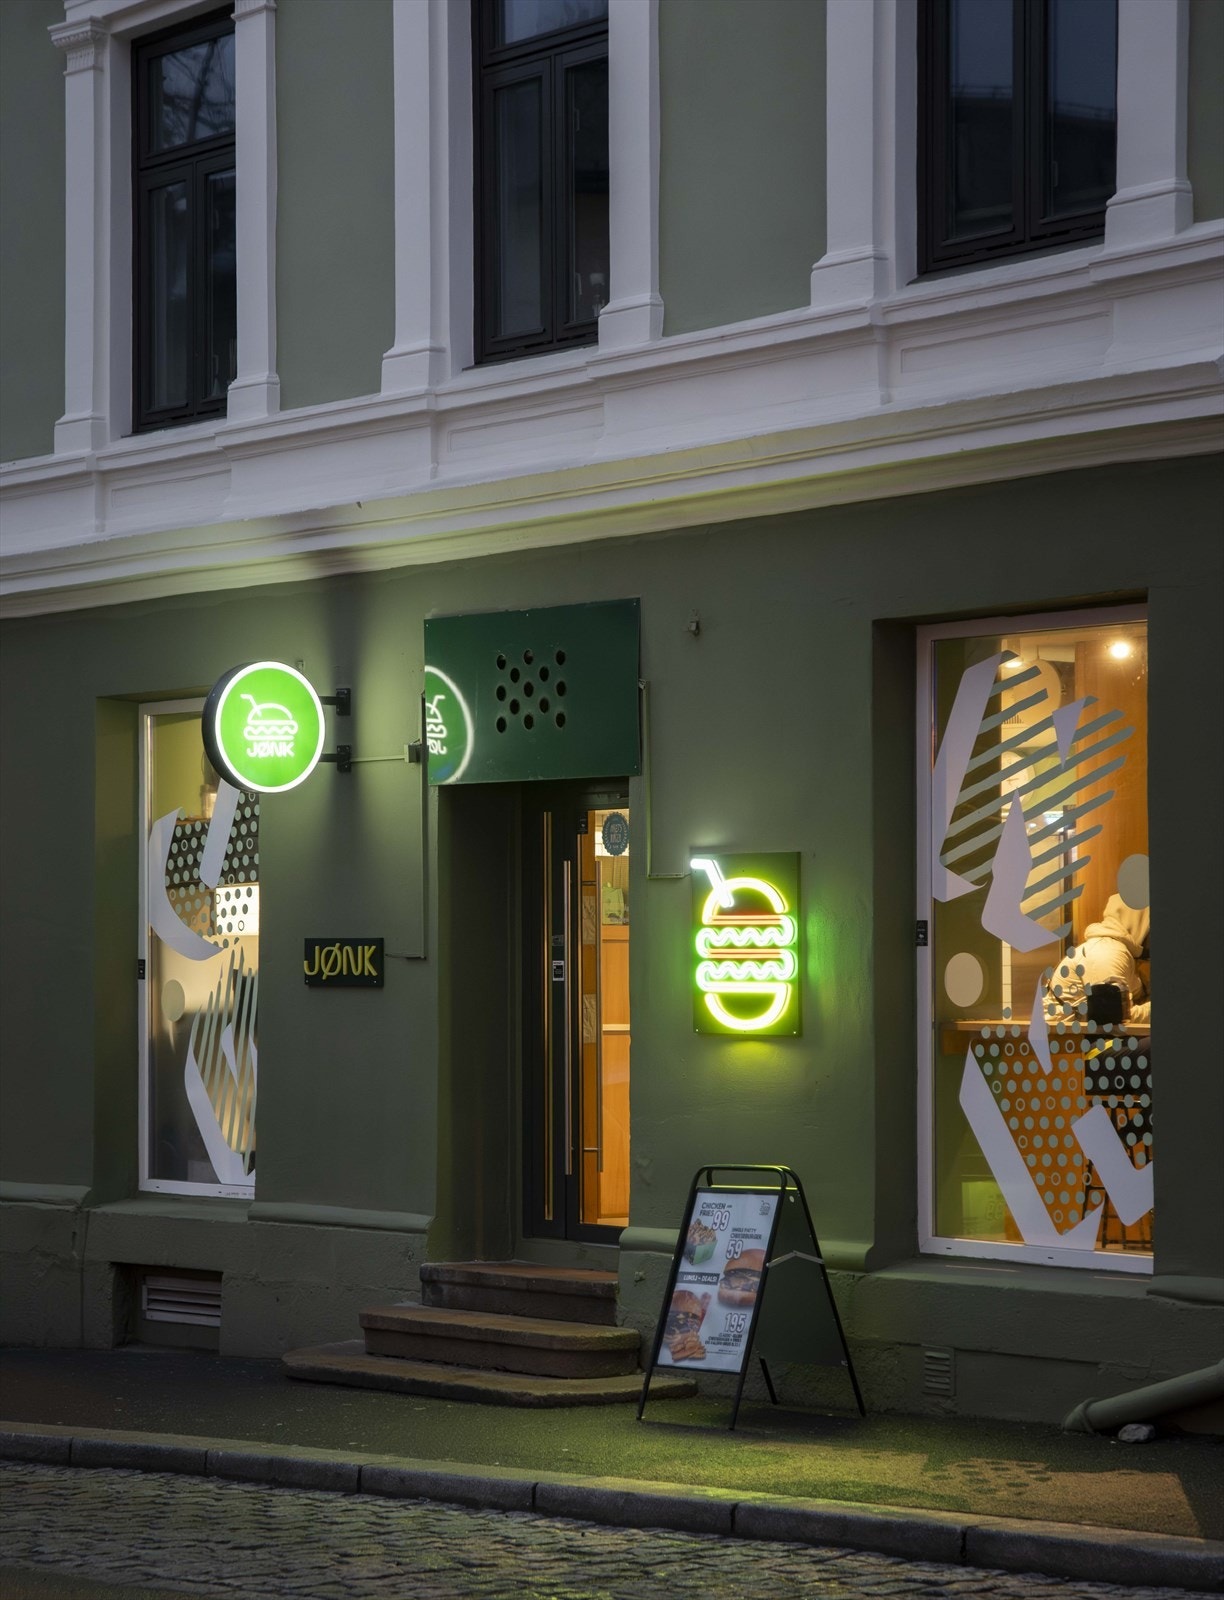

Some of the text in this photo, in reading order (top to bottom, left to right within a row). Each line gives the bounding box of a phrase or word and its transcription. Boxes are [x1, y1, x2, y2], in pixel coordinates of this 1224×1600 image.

[246, 741, 296, 758] JØNK
[304, 942, 378, 980] JØNK
[701, 1202, 726, 1210] CHICKEN
[712, 1210, 731, 1231] 99
[725, 1239, 744, 1260] 59
[725, 1313, 747, 1333] 195
